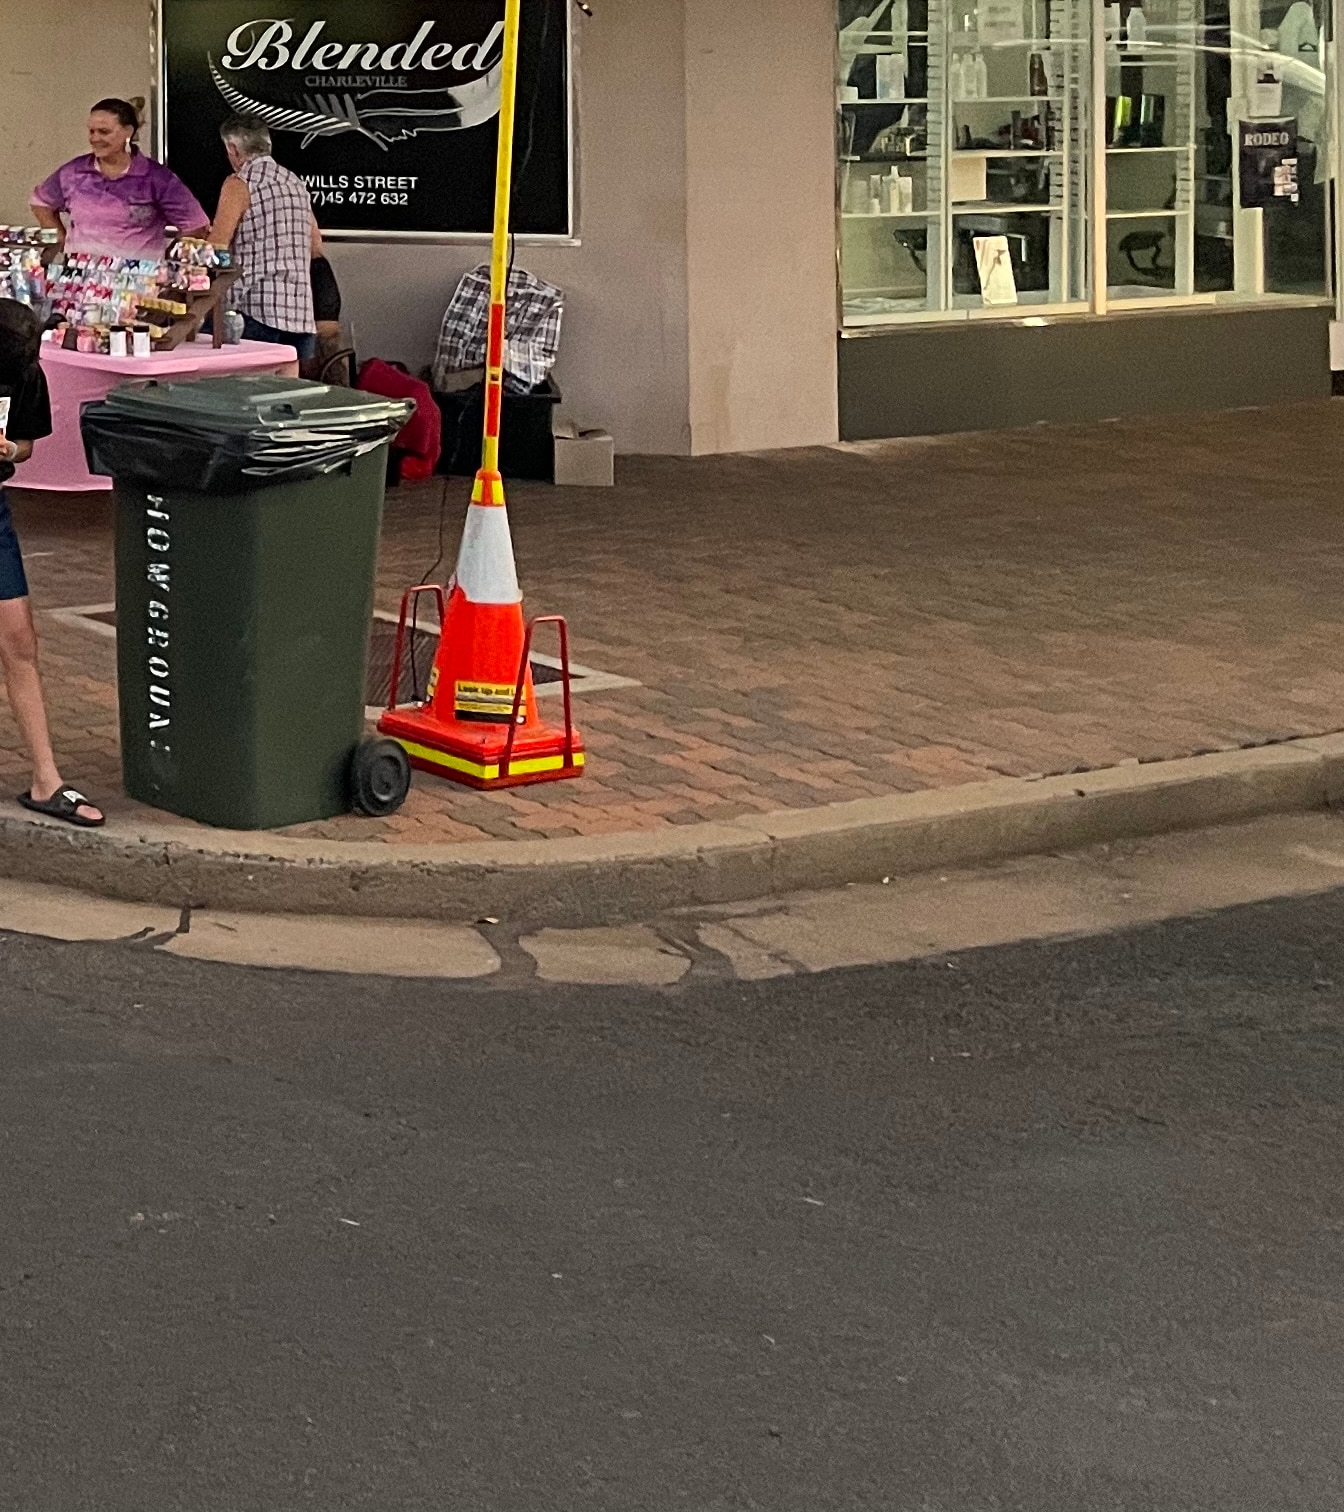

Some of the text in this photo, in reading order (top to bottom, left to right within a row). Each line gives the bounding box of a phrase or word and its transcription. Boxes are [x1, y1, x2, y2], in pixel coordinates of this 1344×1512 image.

[221, 18, 506, 71] Blended
[305, 74, 407, 88] CHARLEVILLE
[1243, 131, 1290, 147] RODEO
[300, 175, 419, 190] WILLS STREET
[348, 191, 377, 206] 472
[380, 192, 409, 206] 632
